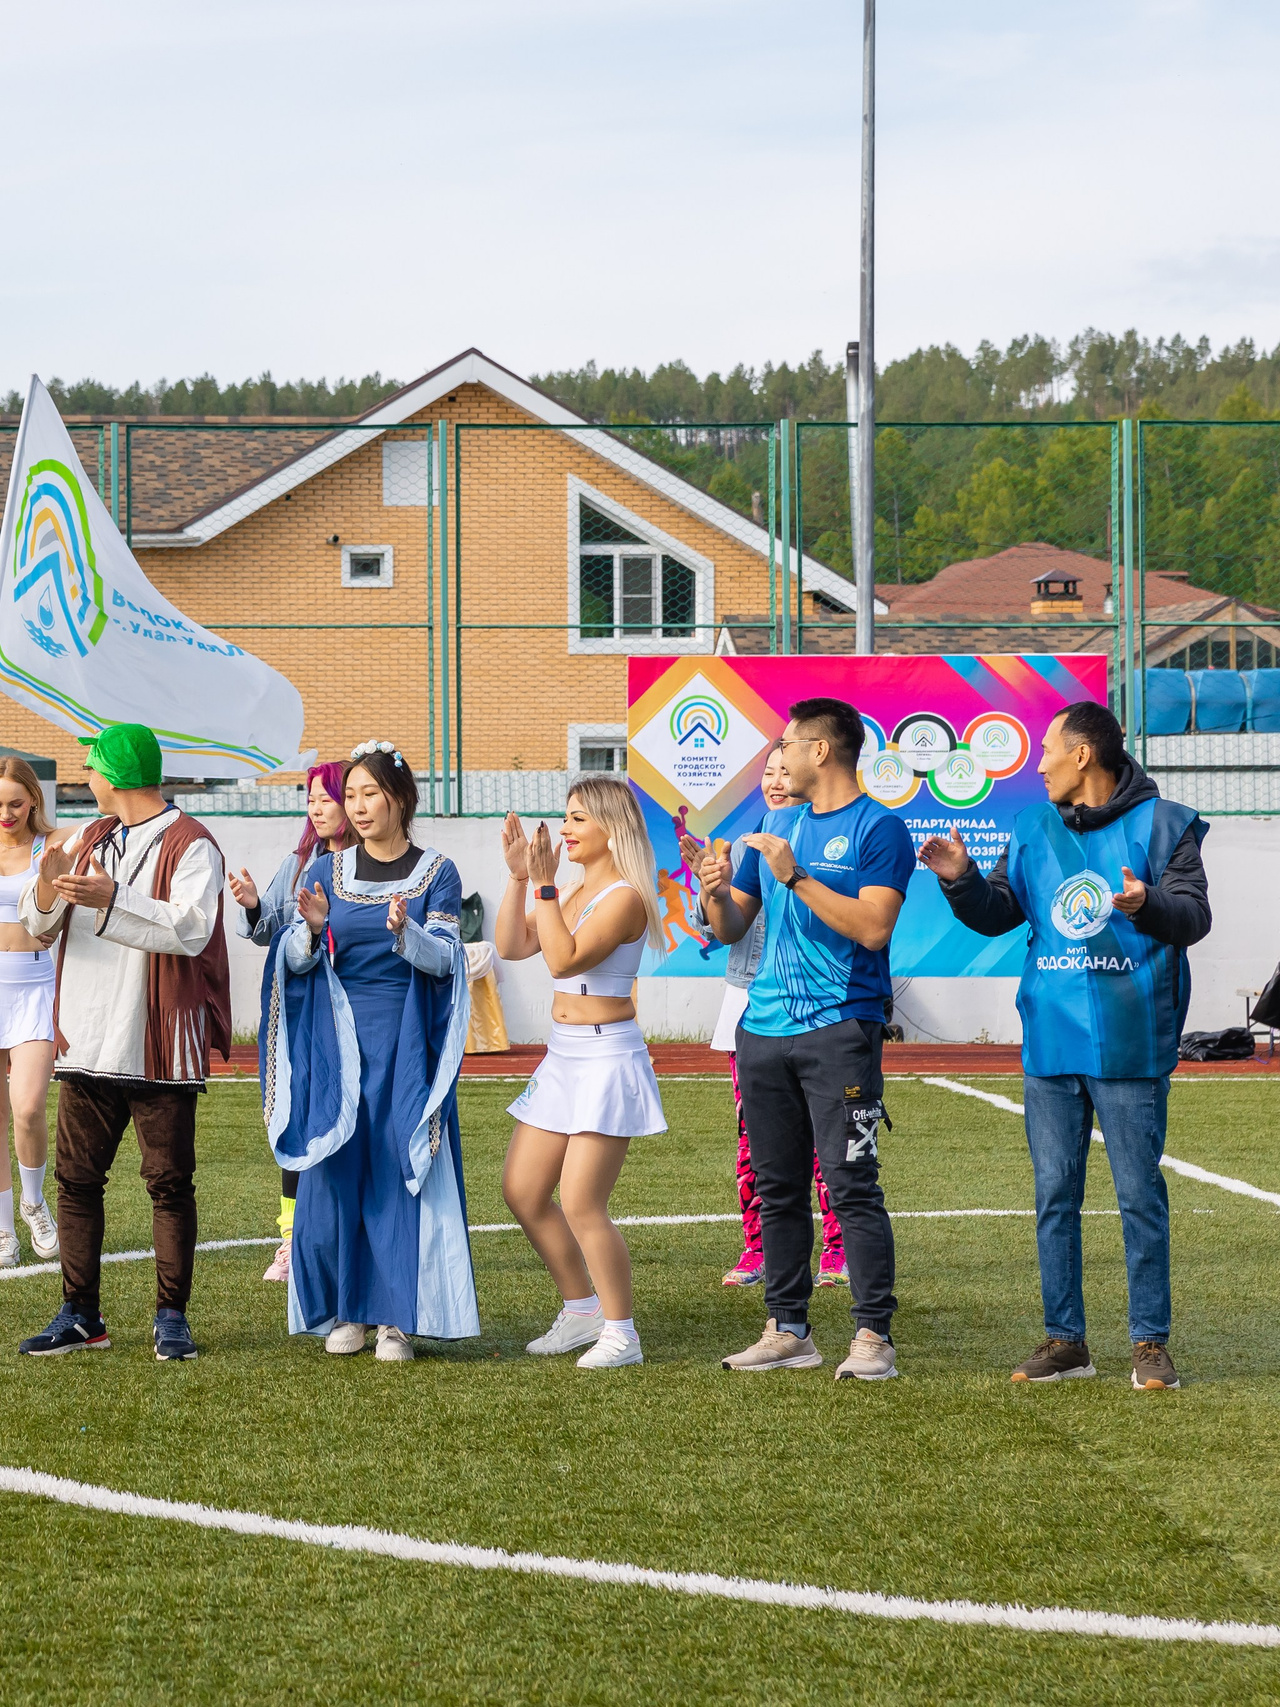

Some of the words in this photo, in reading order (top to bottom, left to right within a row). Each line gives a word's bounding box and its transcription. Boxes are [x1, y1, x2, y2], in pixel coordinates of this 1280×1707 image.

[904, 818, 996, 829] СПАРТАКИАДА
[966, 844, 1005, 857] ХОЗЯЙ
[1066, 946, 1087, 955] МУП
